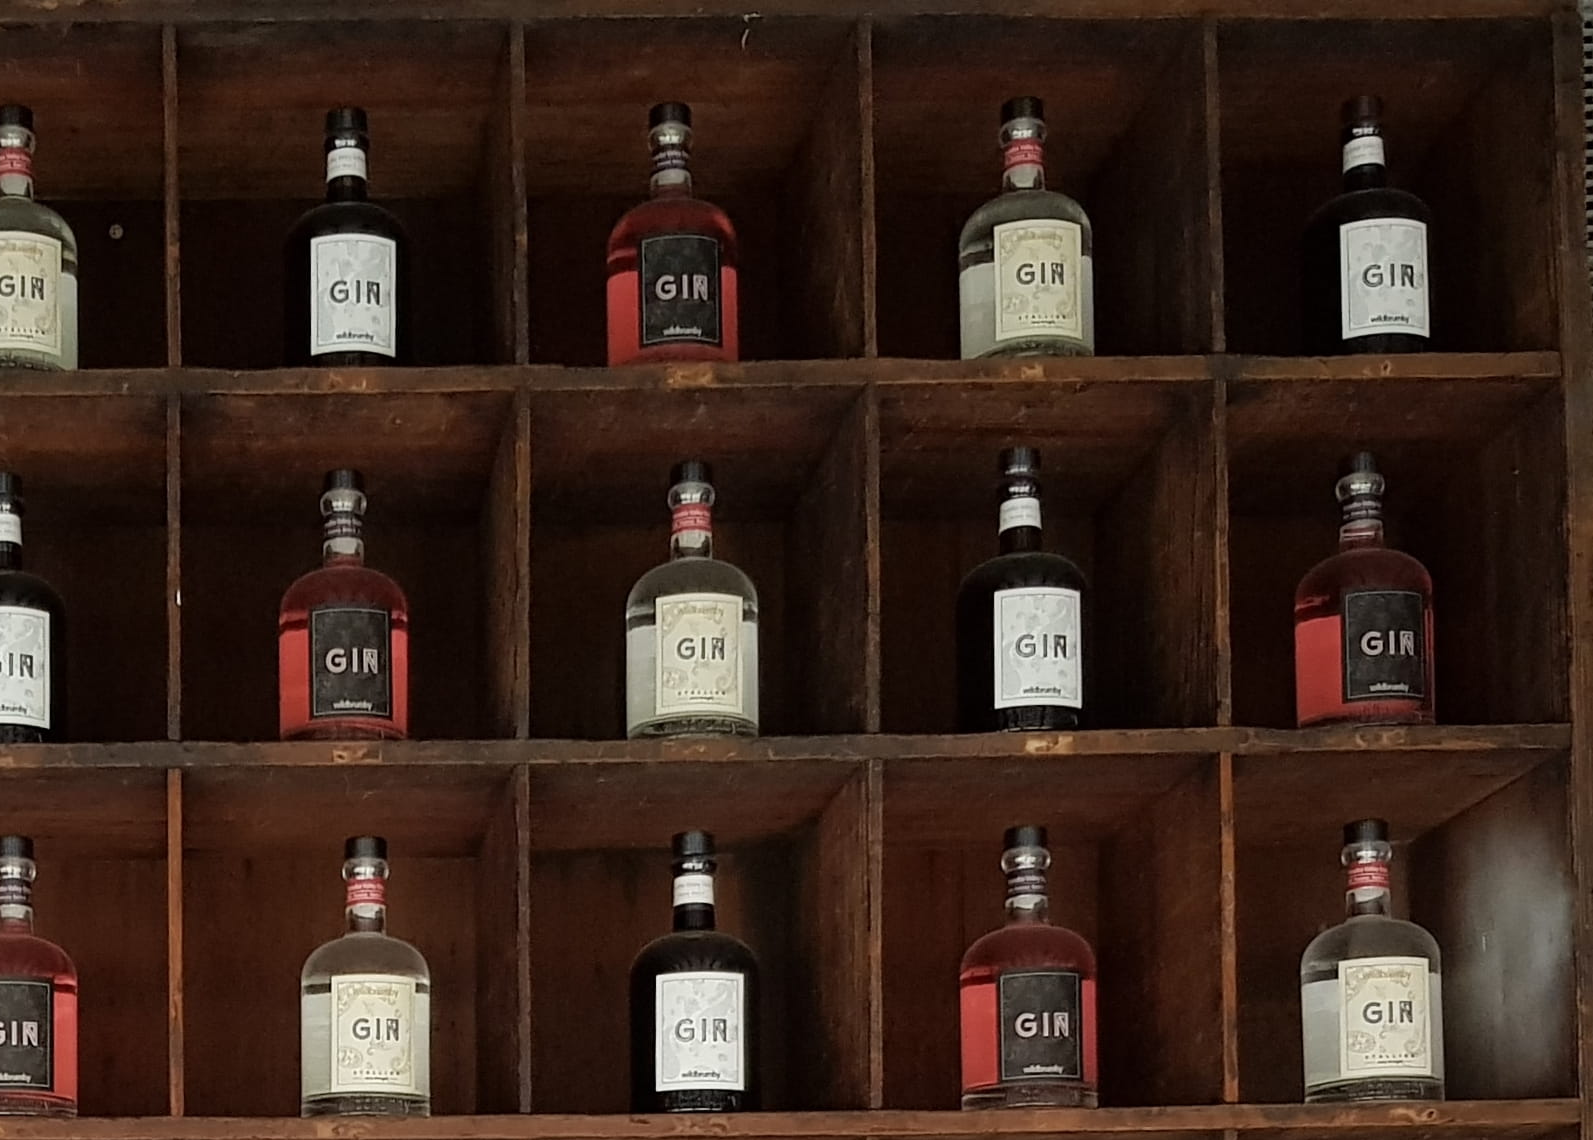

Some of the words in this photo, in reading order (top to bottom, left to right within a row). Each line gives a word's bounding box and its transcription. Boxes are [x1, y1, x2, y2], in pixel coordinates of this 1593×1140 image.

[1016, 263, 1064, 285] GIN
[1362, 264, 1414, 288] GIN
[330, 281, 380, 305] GIN
[655, 274, 708, 301] GIN
[677, 637, 725, 660] GIN
[1015, 634, 1066, 658] GIN
[1361, 631, 1414, 656] GIN
[325, 648, 378, 674] GIN
[1362, 1001, 1413, 1024] GIN
[352, 1018, 399, 1041] GIN
[674, 1018, 728, 1042] GIN
[1015, 1012, 1068, 1038] GIN
